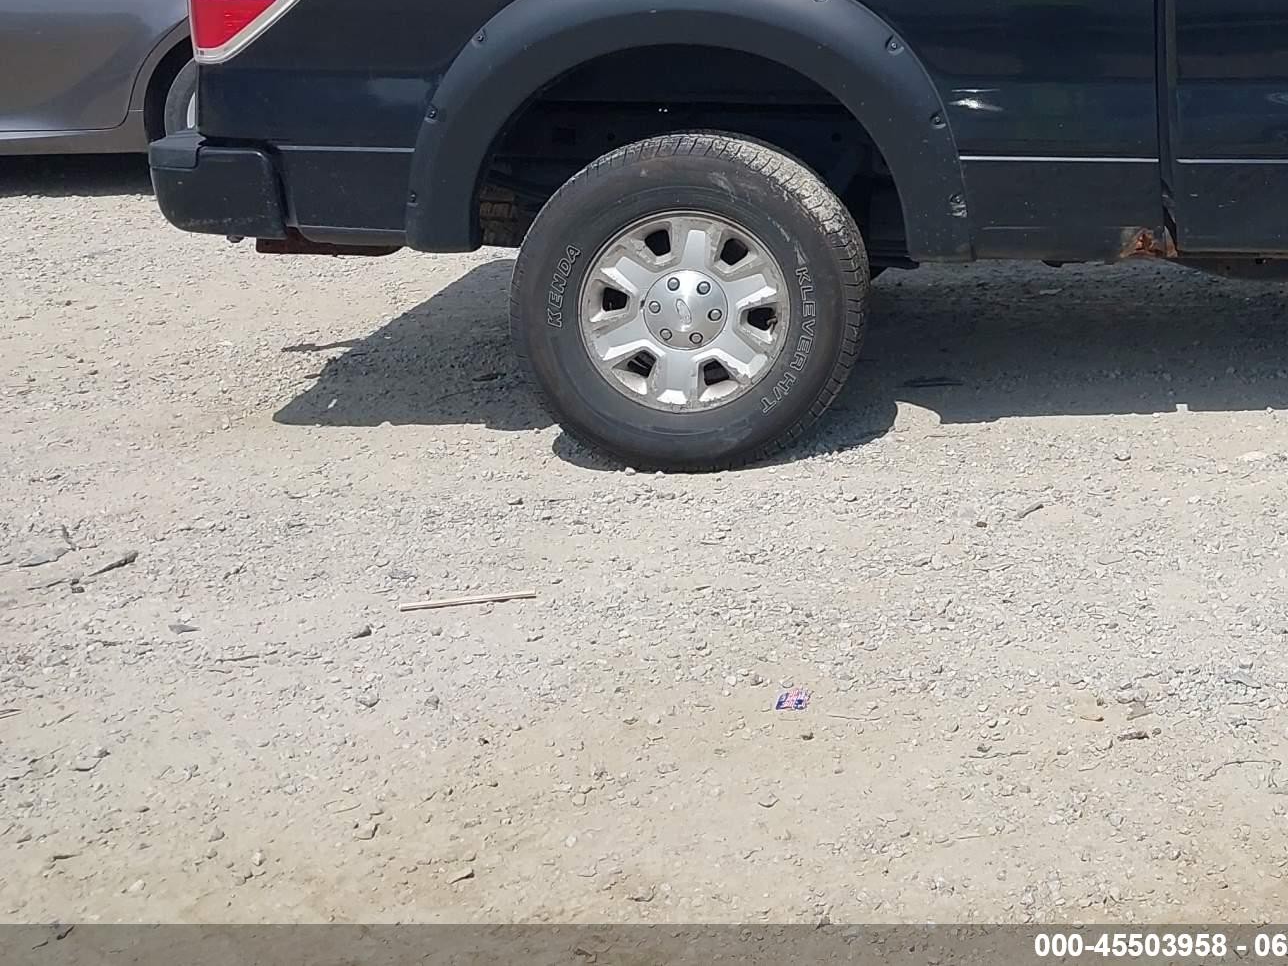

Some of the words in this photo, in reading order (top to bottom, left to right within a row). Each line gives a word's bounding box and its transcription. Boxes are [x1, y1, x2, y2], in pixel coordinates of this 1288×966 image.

[546, 243, 581, 329] KENDA
[789, 266, 817, 373] KLEVER
[760, 372, 797, 414] H/T
